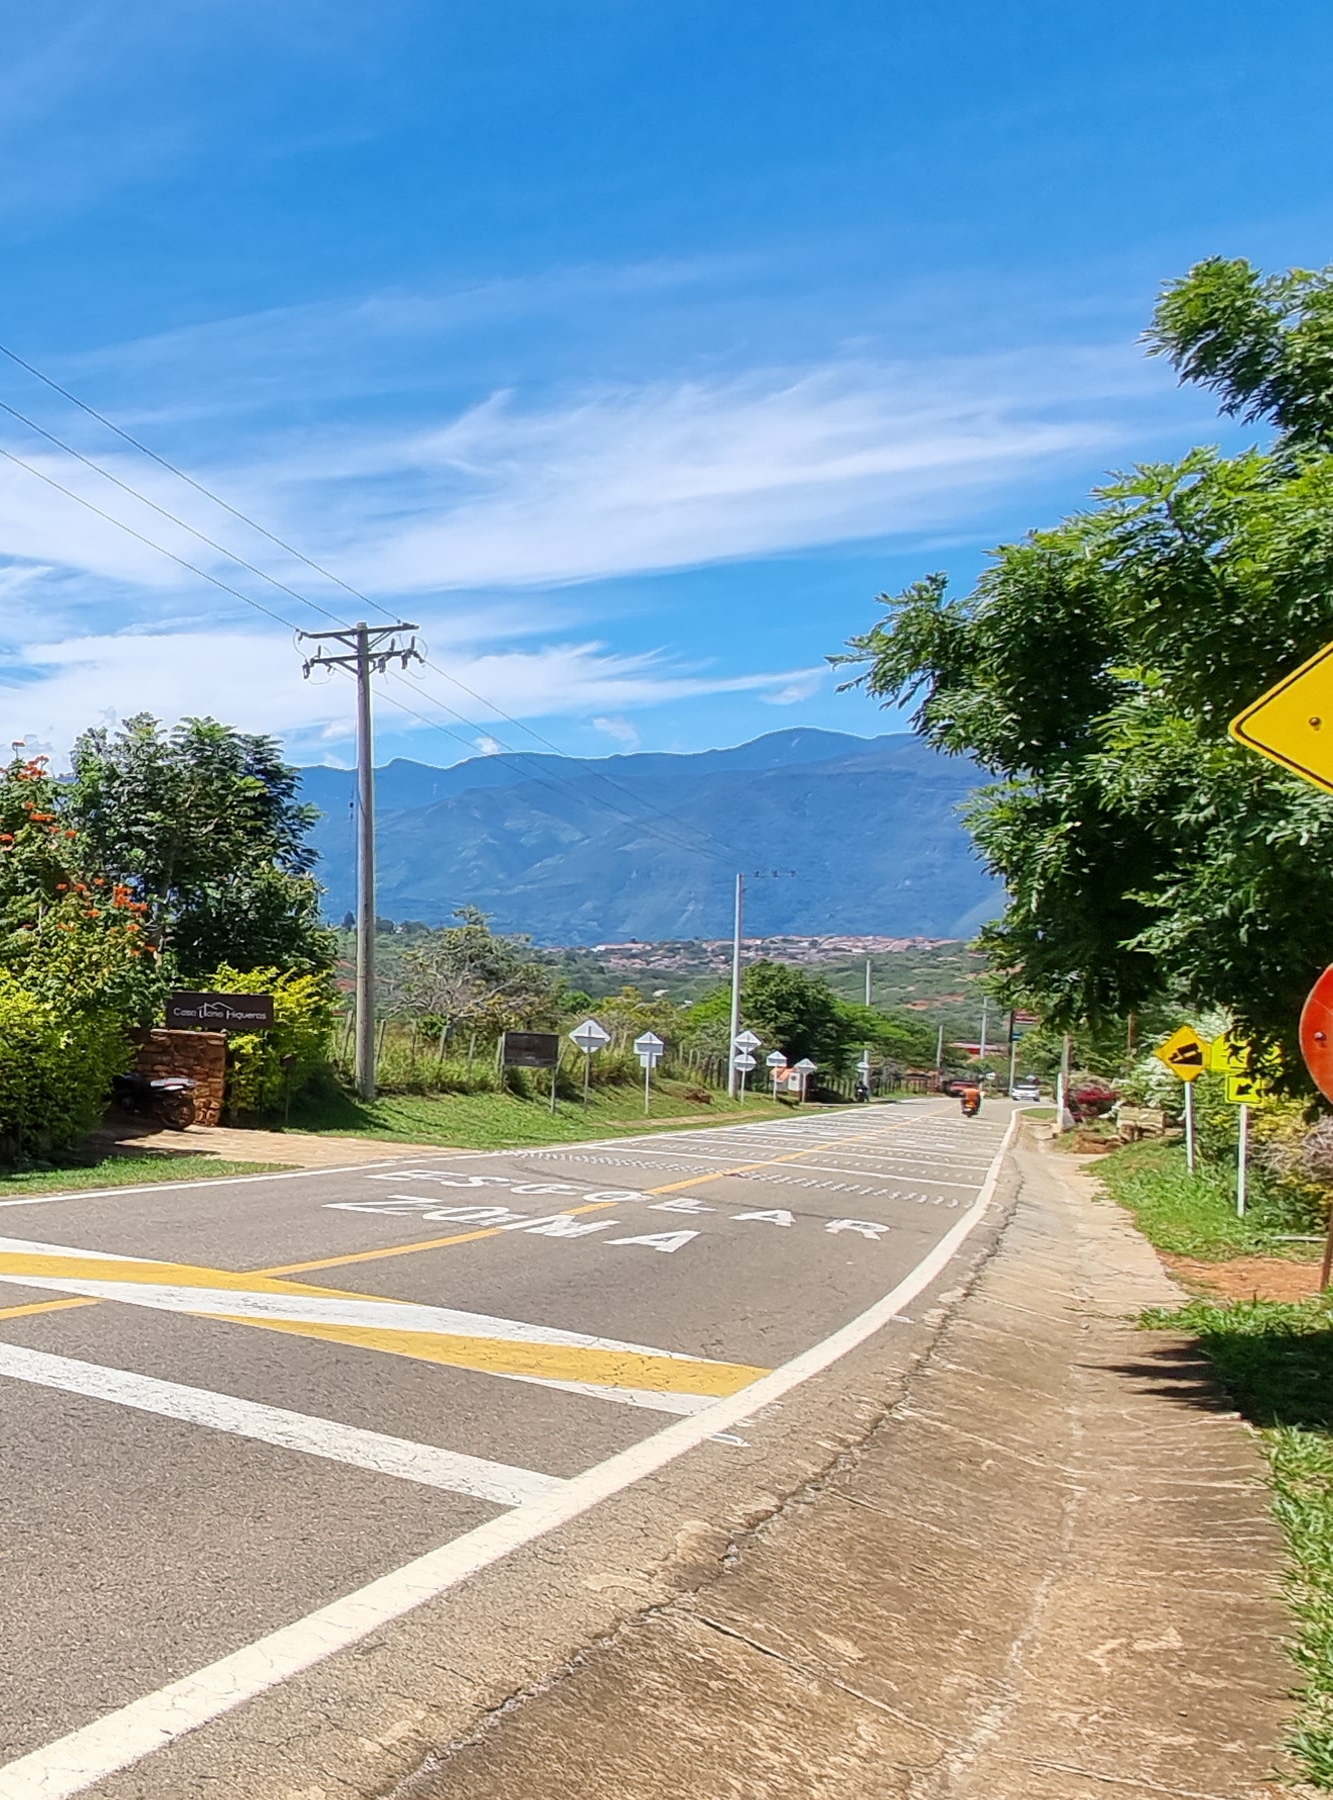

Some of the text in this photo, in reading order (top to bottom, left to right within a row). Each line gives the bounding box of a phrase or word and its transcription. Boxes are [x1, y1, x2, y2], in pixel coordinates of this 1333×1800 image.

[173, 1007, 196, 1017] Casa
[198, 1002, 224, 1019] Llano
[321, 1194, 701, 1253] ZONA
[364, 1169, 891, 1241] ESCOLAR
